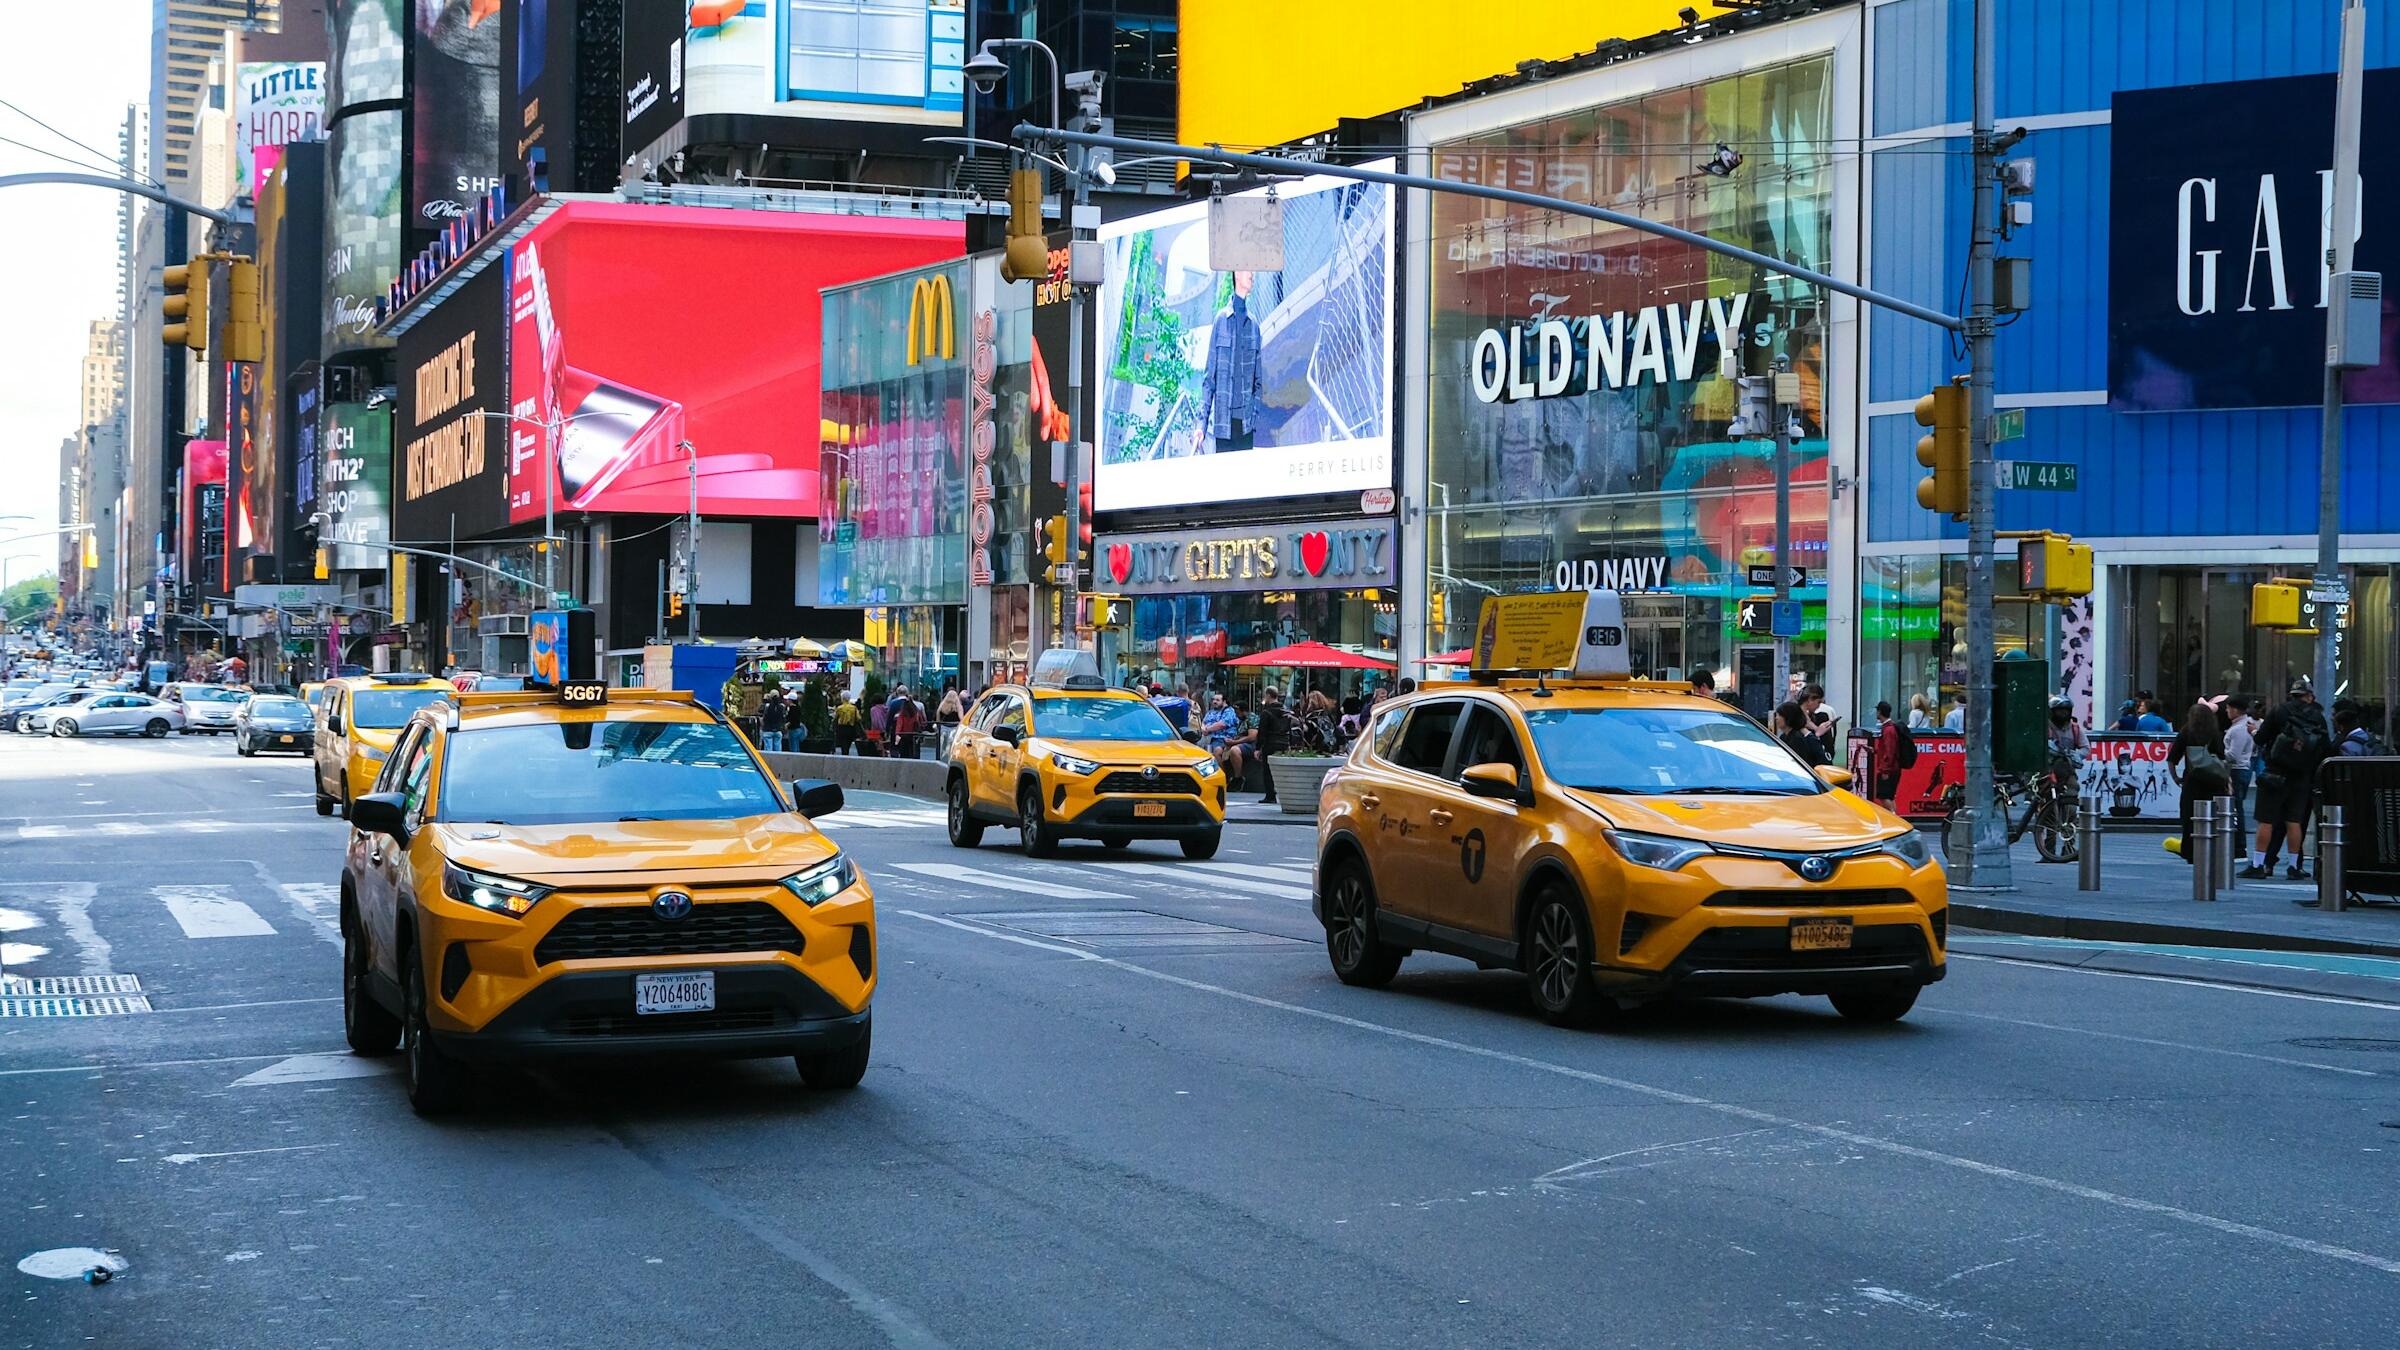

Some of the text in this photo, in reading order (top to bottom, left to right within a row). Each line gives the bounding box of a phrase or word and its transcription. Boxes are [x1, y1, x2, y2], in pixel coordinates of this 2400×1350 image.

[251, 68, 317, 105] LITTLE
[1472, 293, 1748, 403] OLD NAVY
[415, 330, 476, 428] INTRODUCING THE
[406, 406, 486, 501] MOST REWARDING CARD
[1289, 455, 1385, 477] PERRY ELLIS
[2016, 465, 2075, 487] W 44 St
[1184, 536, 1278, 581] GIFTS
[1555, 556, 1666, 591] OLD NAVY
[1756, 571, 1773, 580] ONE
[1591, 628, 1616, 645] 3E16
[563, 685, 604, 701] 5G67
[656, 974, 695, 983] NEW YORK
[644, 982, 708, 1005] Y206488C
